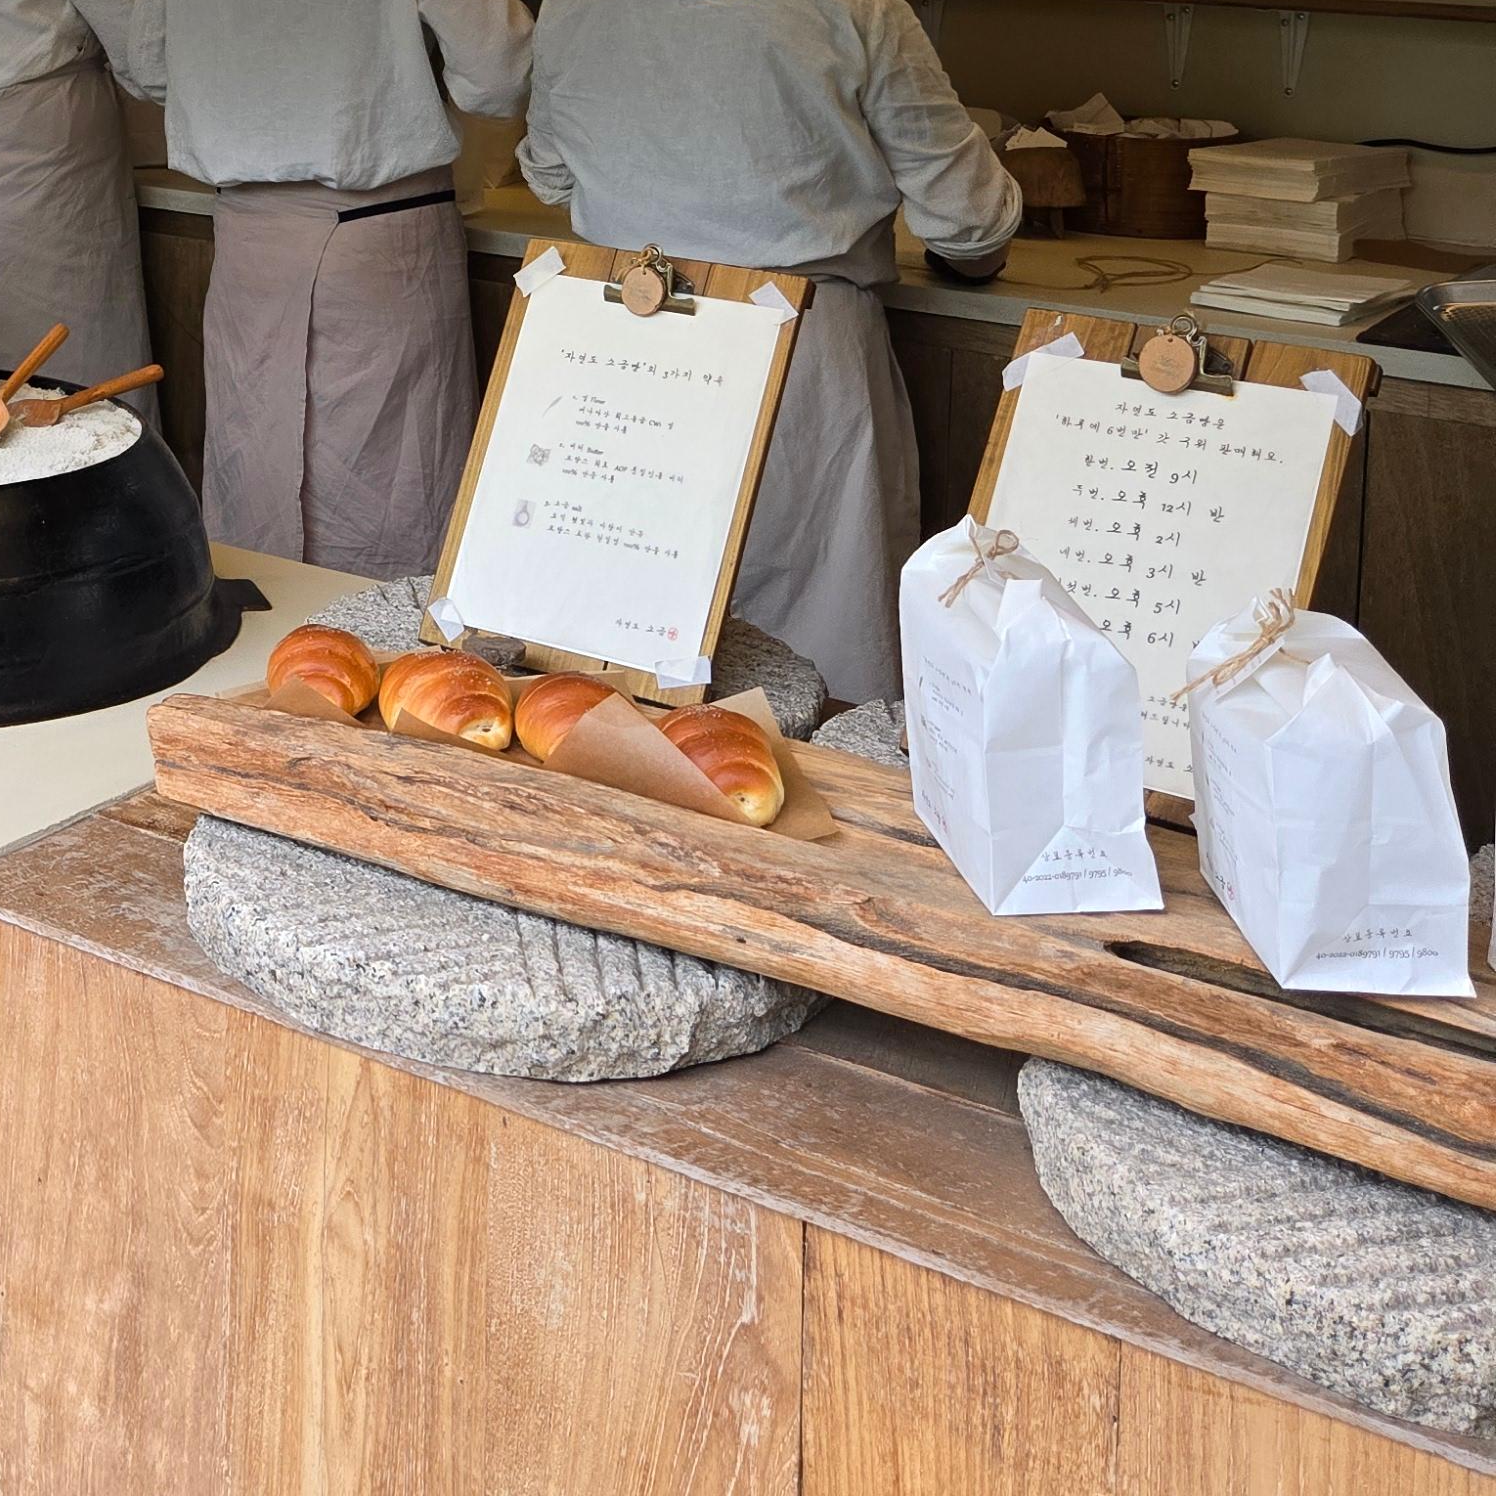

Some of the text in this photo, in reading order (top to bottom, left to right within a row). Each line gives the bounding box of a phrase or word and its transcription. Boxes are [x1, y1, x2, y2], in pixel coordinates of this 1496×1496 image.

[1115, 402, 1225, 430] 자연도 소금빵은
[1156, 432, 1170, 444] 갓
[1179, 437, 1207, 451] 구워
[1121, 459, 1159, 479] 오전
[1168, 469, 1198, 485] 9시
[1111, 490, 1147, 510] 오후
[1161, 500, 1192, 516] 12시
[1209, 506, 1225, 523] 반
[1106, 521, 1142, 541] 오후
[1155, 531, 1181, 547] 2시
[1098, 552, 1134, 573] 오후
[1145, 563, 1173, 579] 3시
[1191, 569, 1206, 587] 반
[1058, 577, 1181, 615] 섯번. 오후 5시
[1099, 619, 1133, 640] 오후
[1147, 631, 1175, 648] 6시
[1388, 951, 1410, 959] 9795
